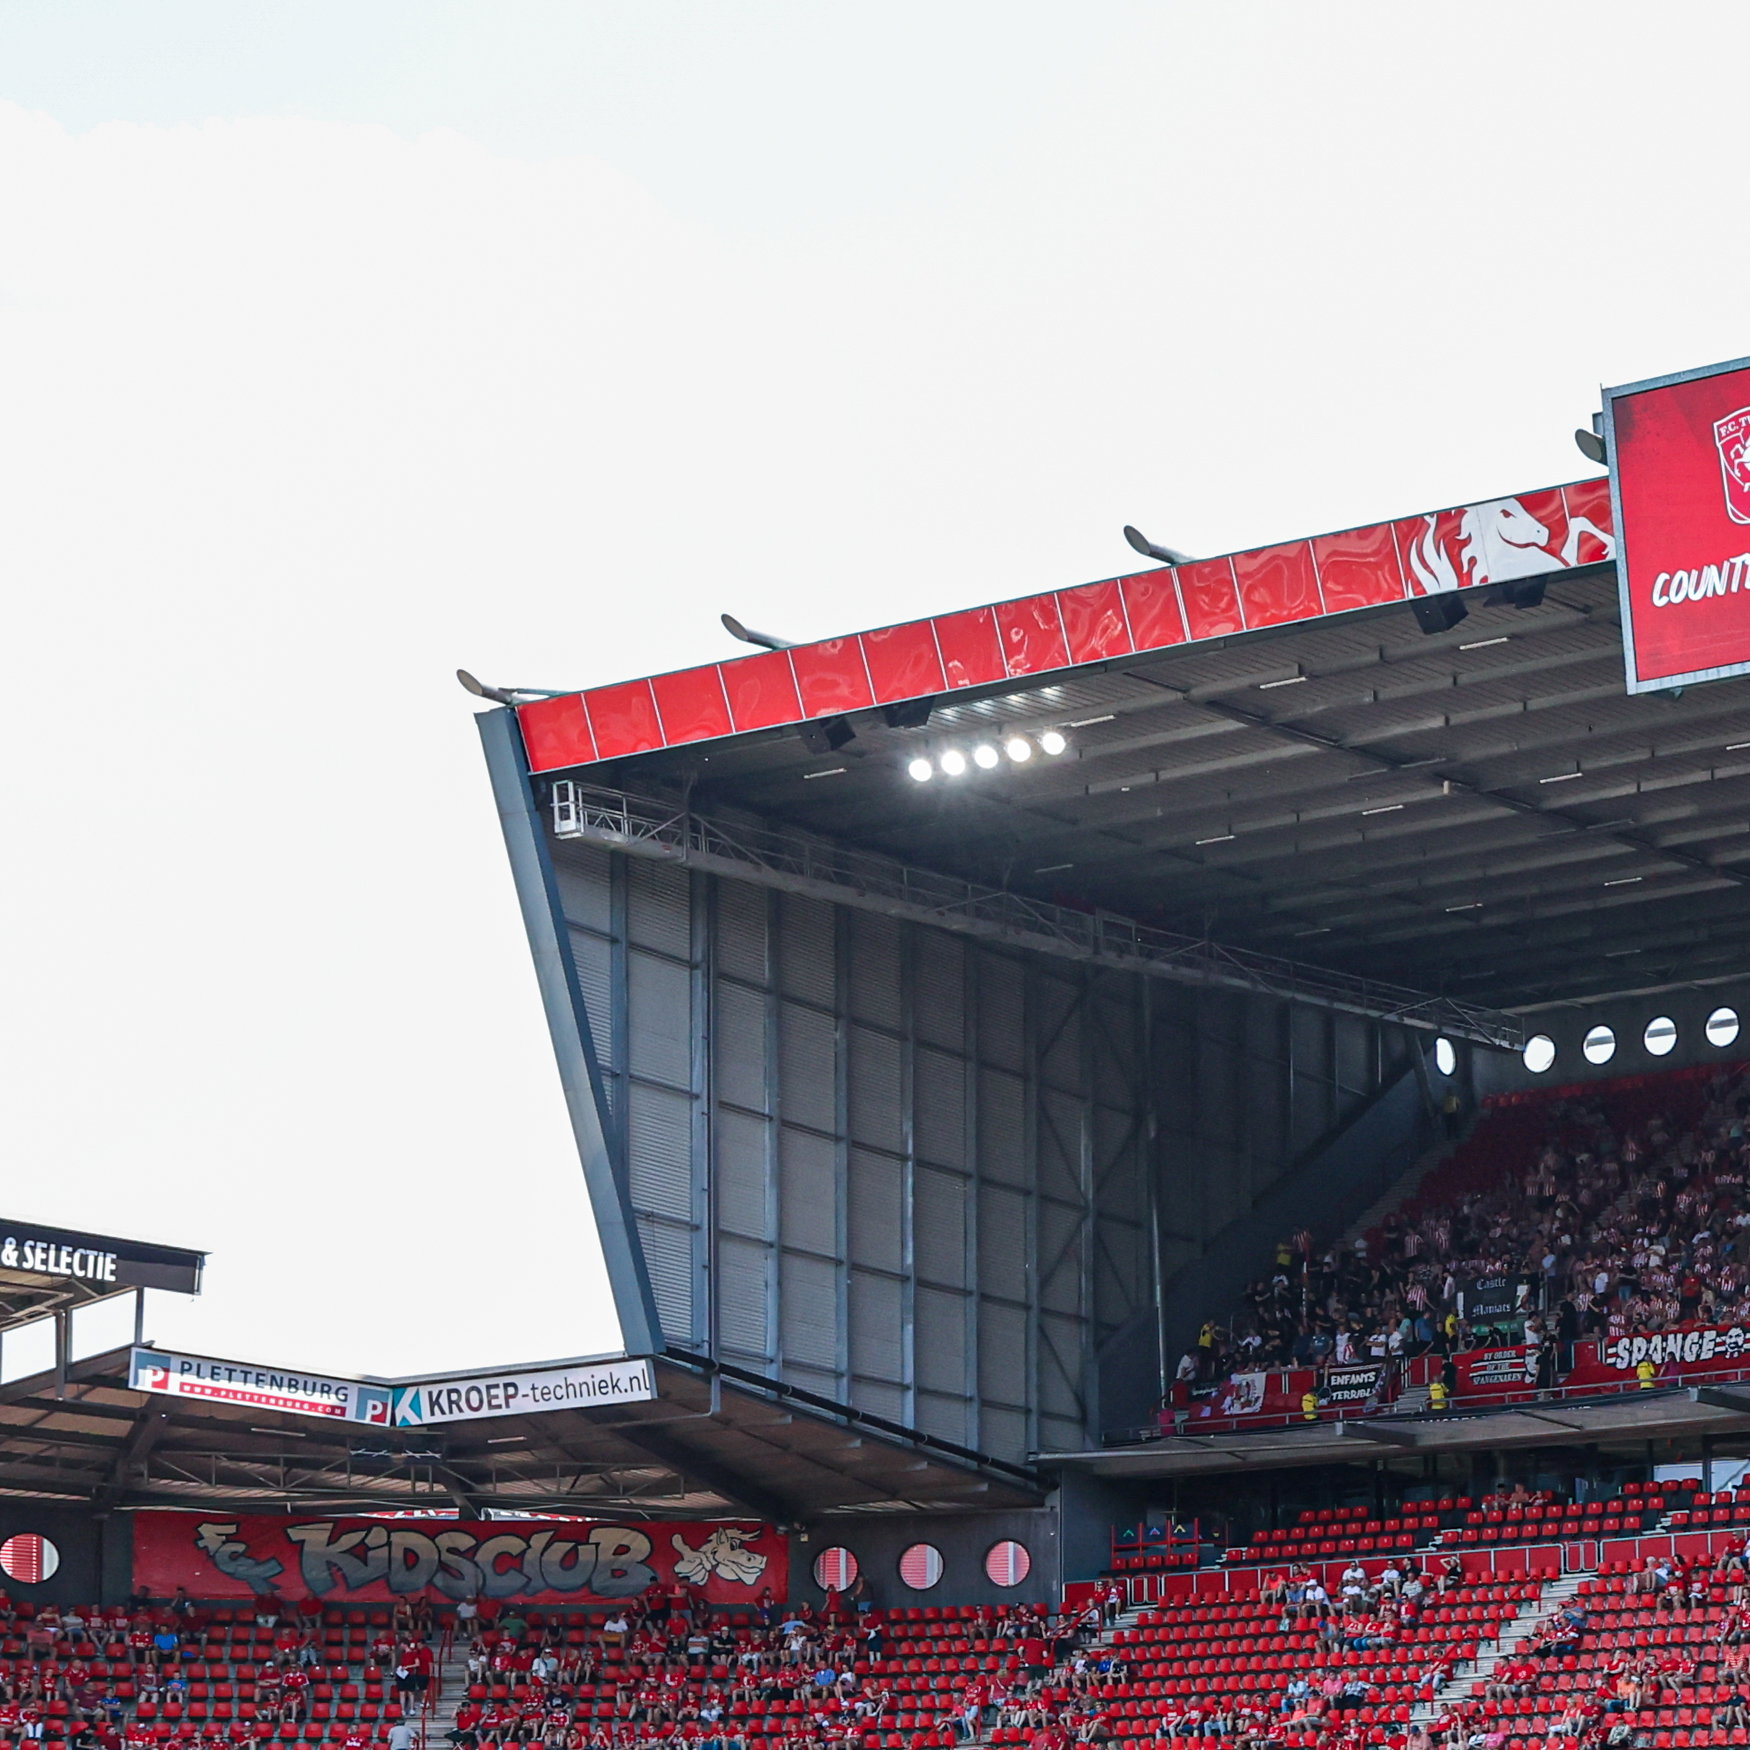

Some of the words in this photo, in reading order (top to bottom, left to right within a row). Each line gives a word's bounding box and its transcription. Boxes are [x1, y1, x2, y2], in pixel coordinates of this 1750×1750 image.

[22, 1240, 118, 1282] SELECTIE
[180, 1360, 349, 1403] PLETTENBURG
[427, 1368, 650, 1417] KROEP-techniek.nl
